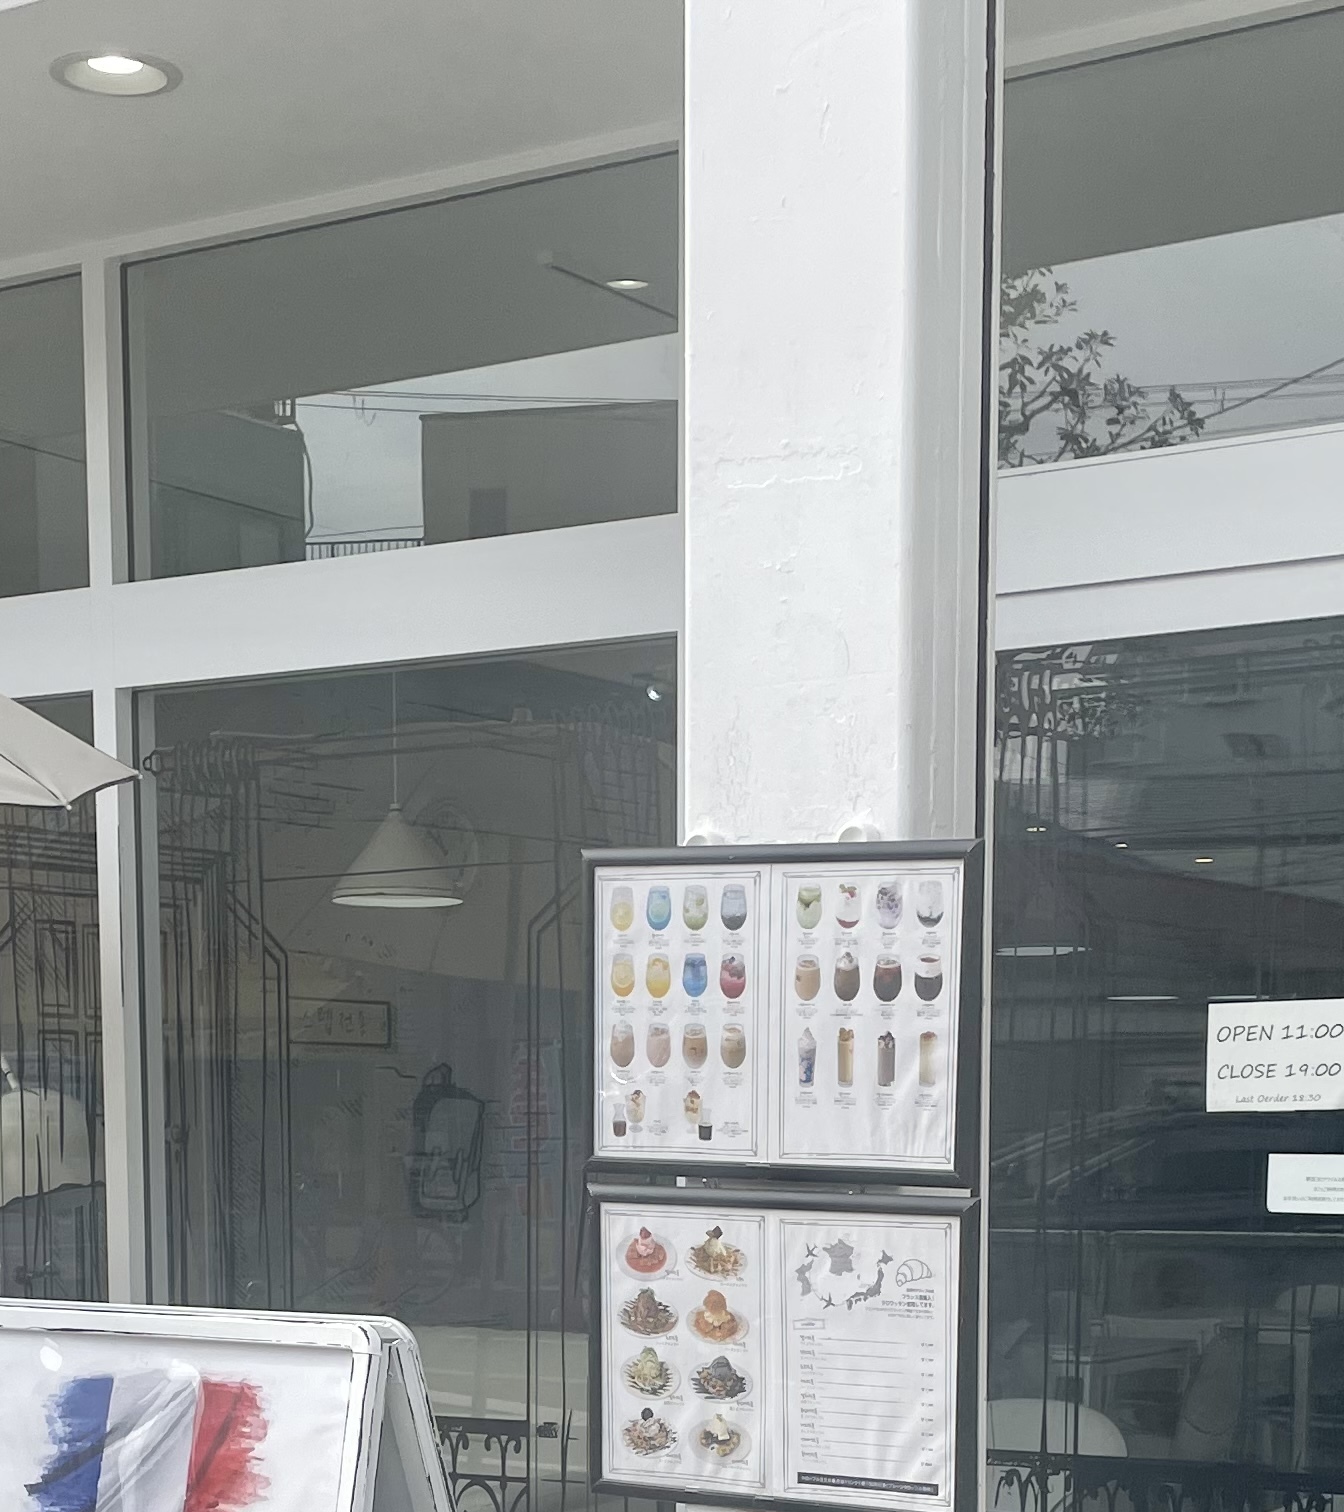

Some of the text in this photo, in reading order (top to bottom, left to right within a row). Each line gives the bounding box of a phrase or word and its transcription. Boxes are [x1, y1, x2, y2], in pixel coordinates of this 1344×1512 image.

[1216, 1023, 1344, 1043] OPEN 11:00
[1217, 1062, 1342, 1080] CLOSE 19:00
[1235, 1094, 1254, 1103] Last
